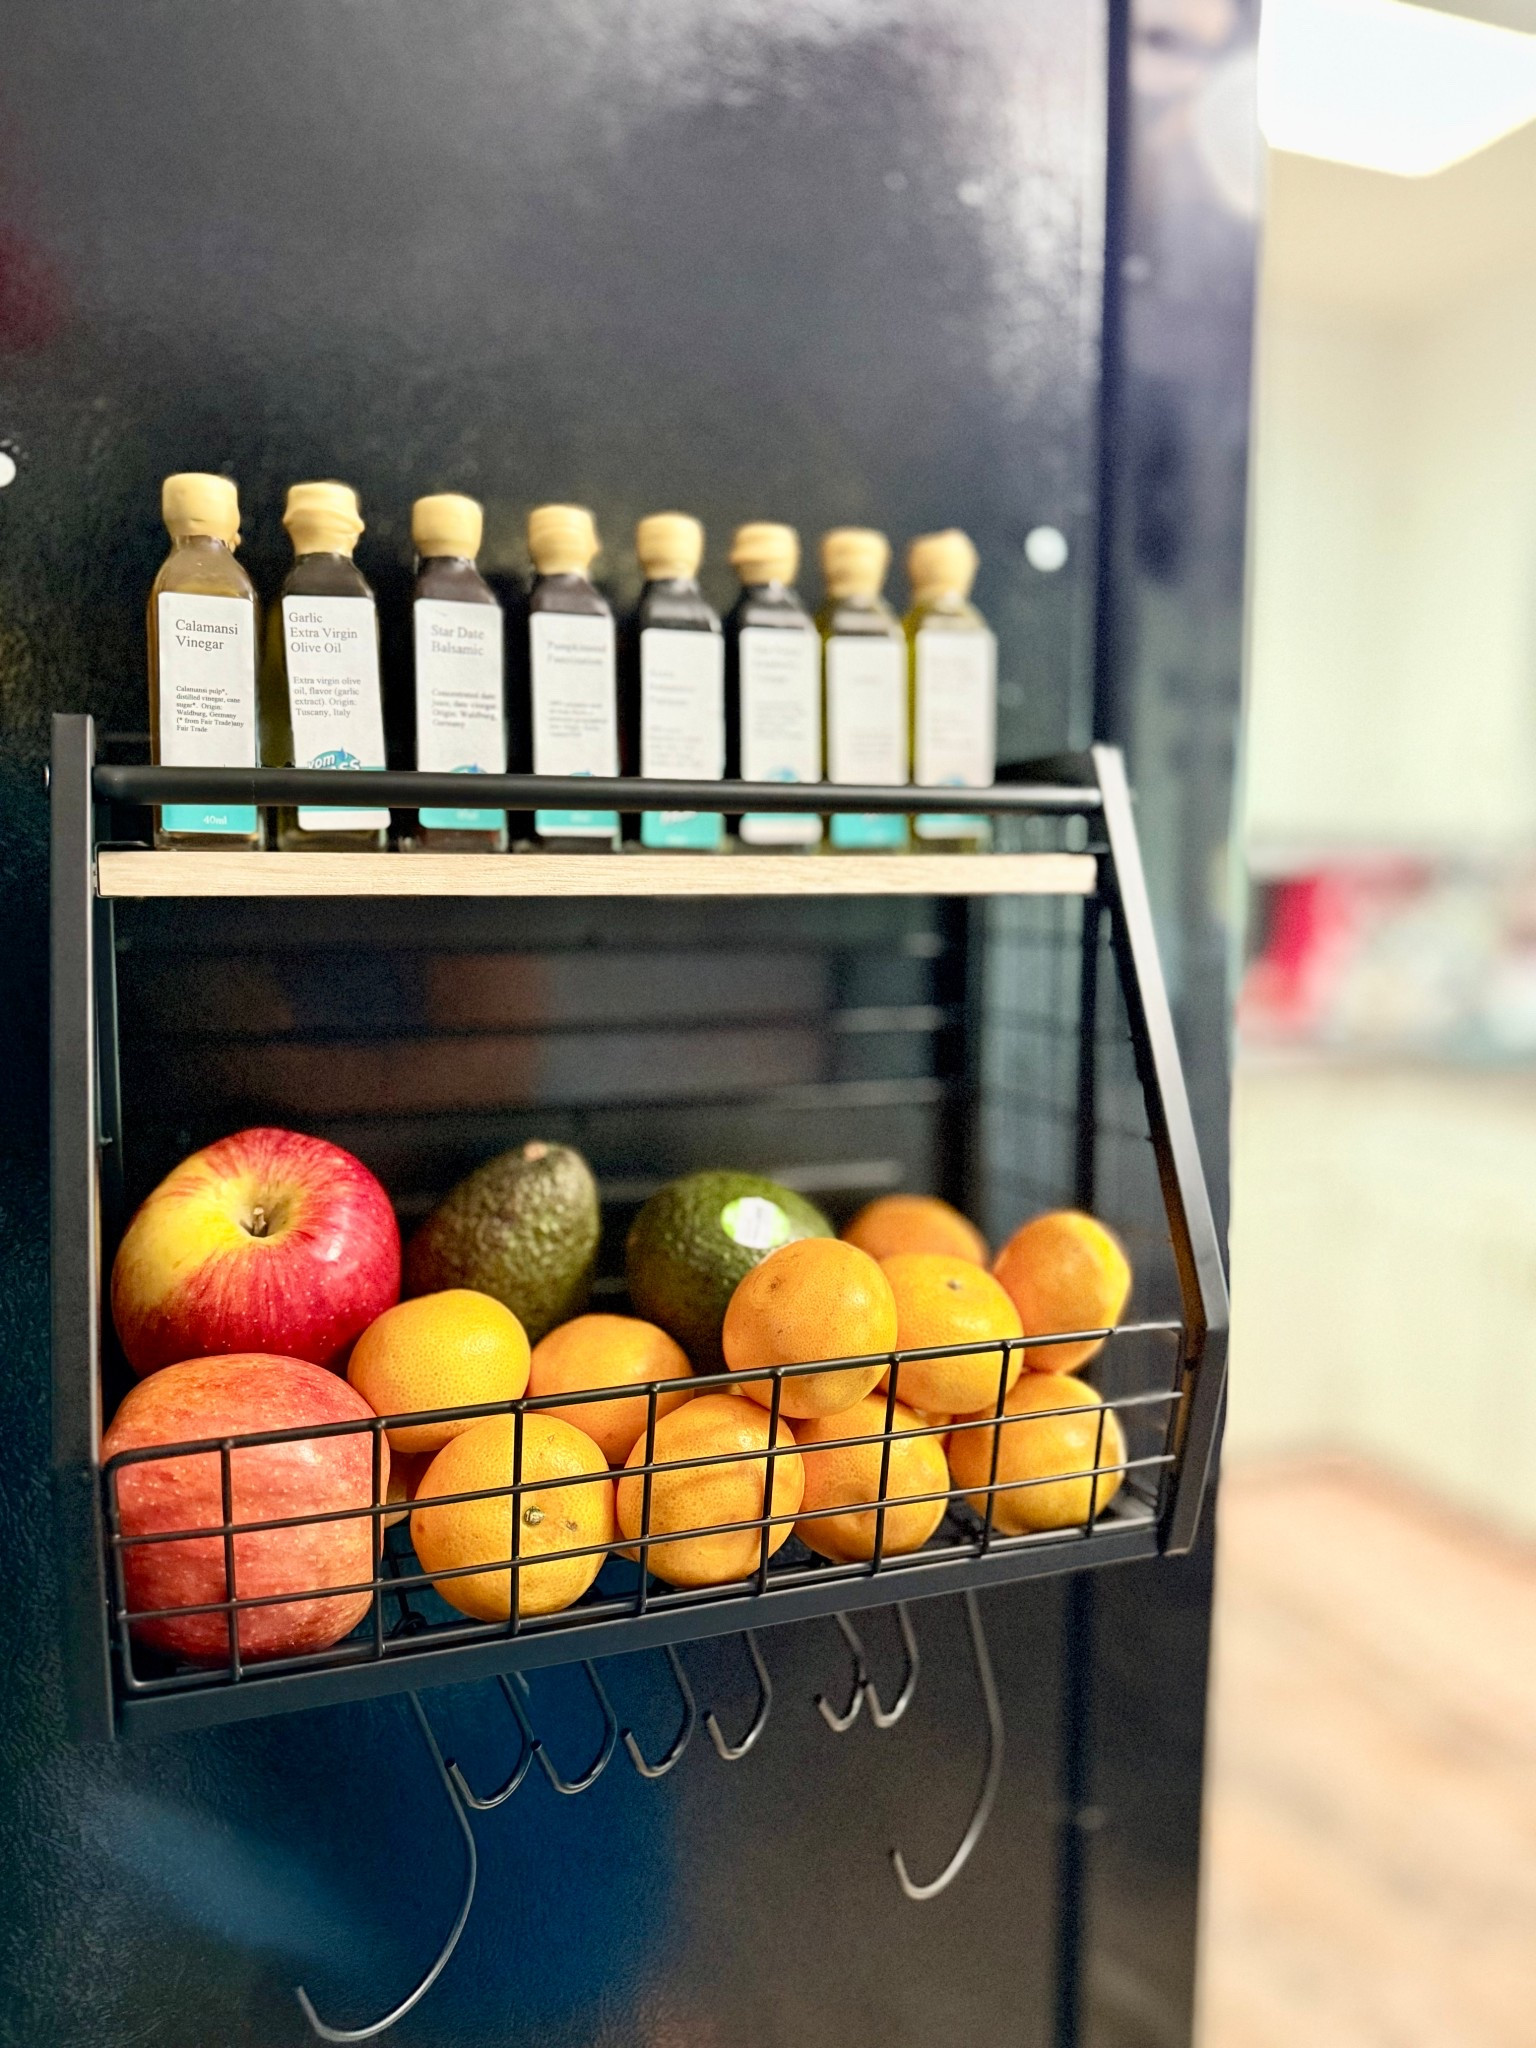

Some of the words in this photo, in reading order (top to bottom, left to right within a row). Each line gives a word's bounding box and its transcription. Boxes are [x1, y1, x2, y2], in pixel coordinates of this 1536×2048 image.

[288, 611, 323, 624] Garlic
[175, 619, 238, 635] Calamansi
[431, 624, 454, 638] Star
[457, 626, 485, 641] Date
[290, 626, 320, 638] Extra
[322, 627, 358, 642] Virgin
[175, 635, 225, 652] Vinegar
[290, 641, 322, 653] Olive
[324, 642, 342, 654] Oil
[431, 640, 485, 656] Balsamic
[293, 676, 315, 685] Extra
[315, 676, 340, 686] virgin
[341, 676, 362, 685] olive
[309, 687, 333, 695] flavor
[333, 708, 351, 719] Italy
[176, 724, 189, 732] Fair
[190, 725, 208, 733] Trade
